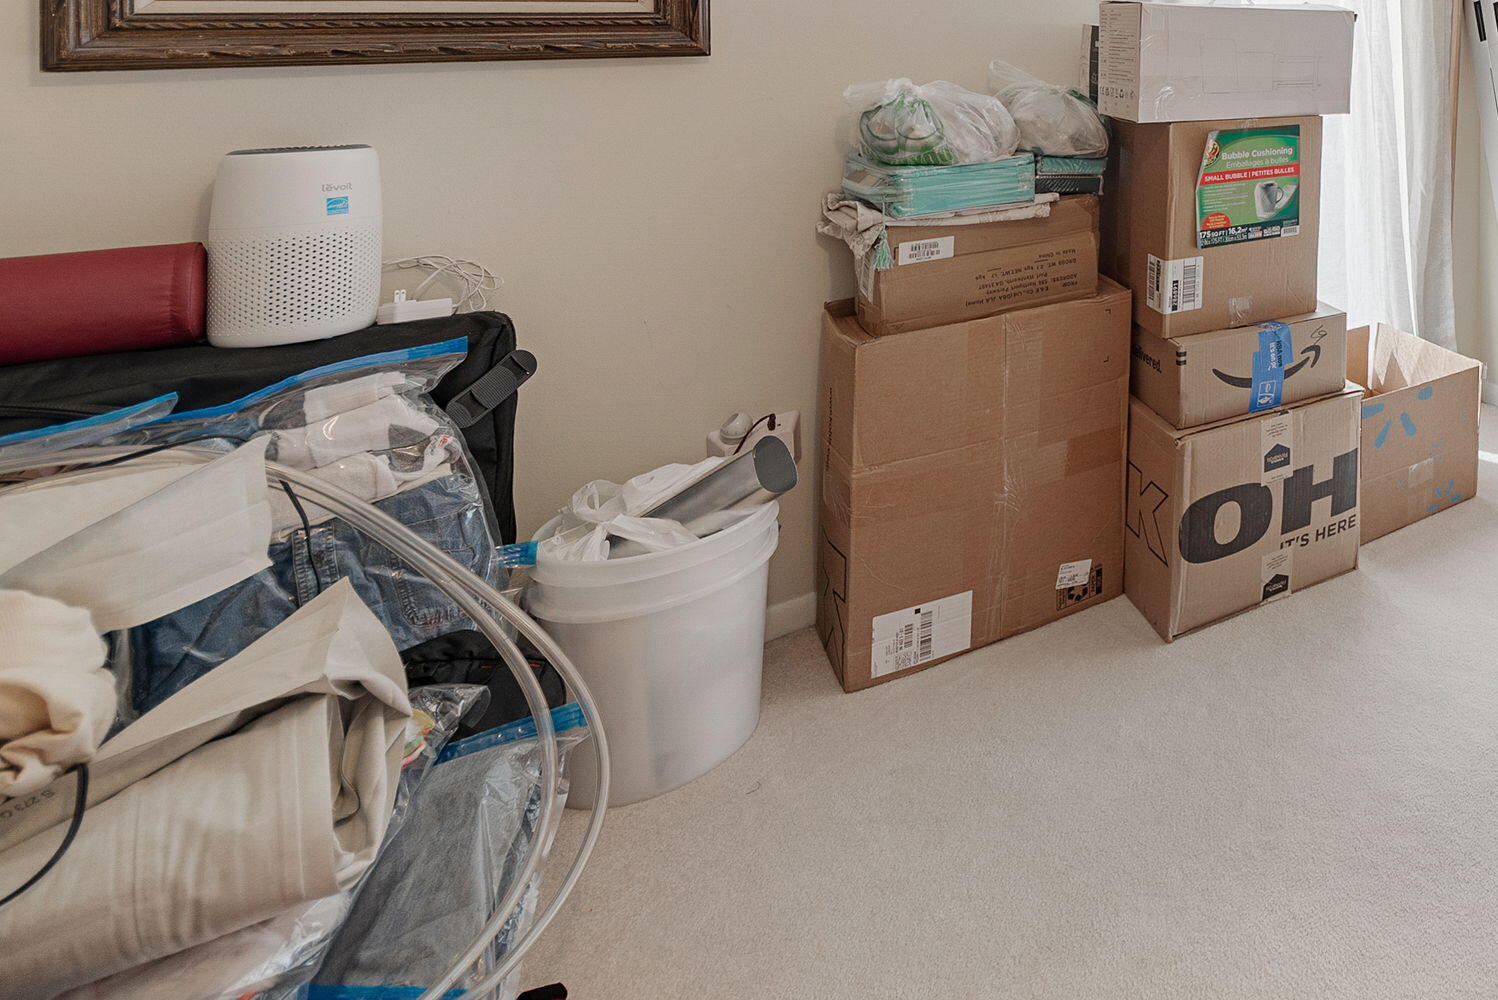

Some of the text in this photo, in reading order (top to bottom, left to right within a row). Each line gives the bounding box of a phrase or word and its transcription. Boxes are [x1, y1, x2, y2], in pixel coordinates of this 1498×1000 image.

[1221, 146, 1294, 160] Bubble Cushioning
[1204, 167, 1295, 183] SMALL BUBBLE PETITES BULLES
[1133, 345, 1163, 374] elivered.
[1178, 447, 1359, 564] OH
[1315, 514, 1357, 543] HERE
